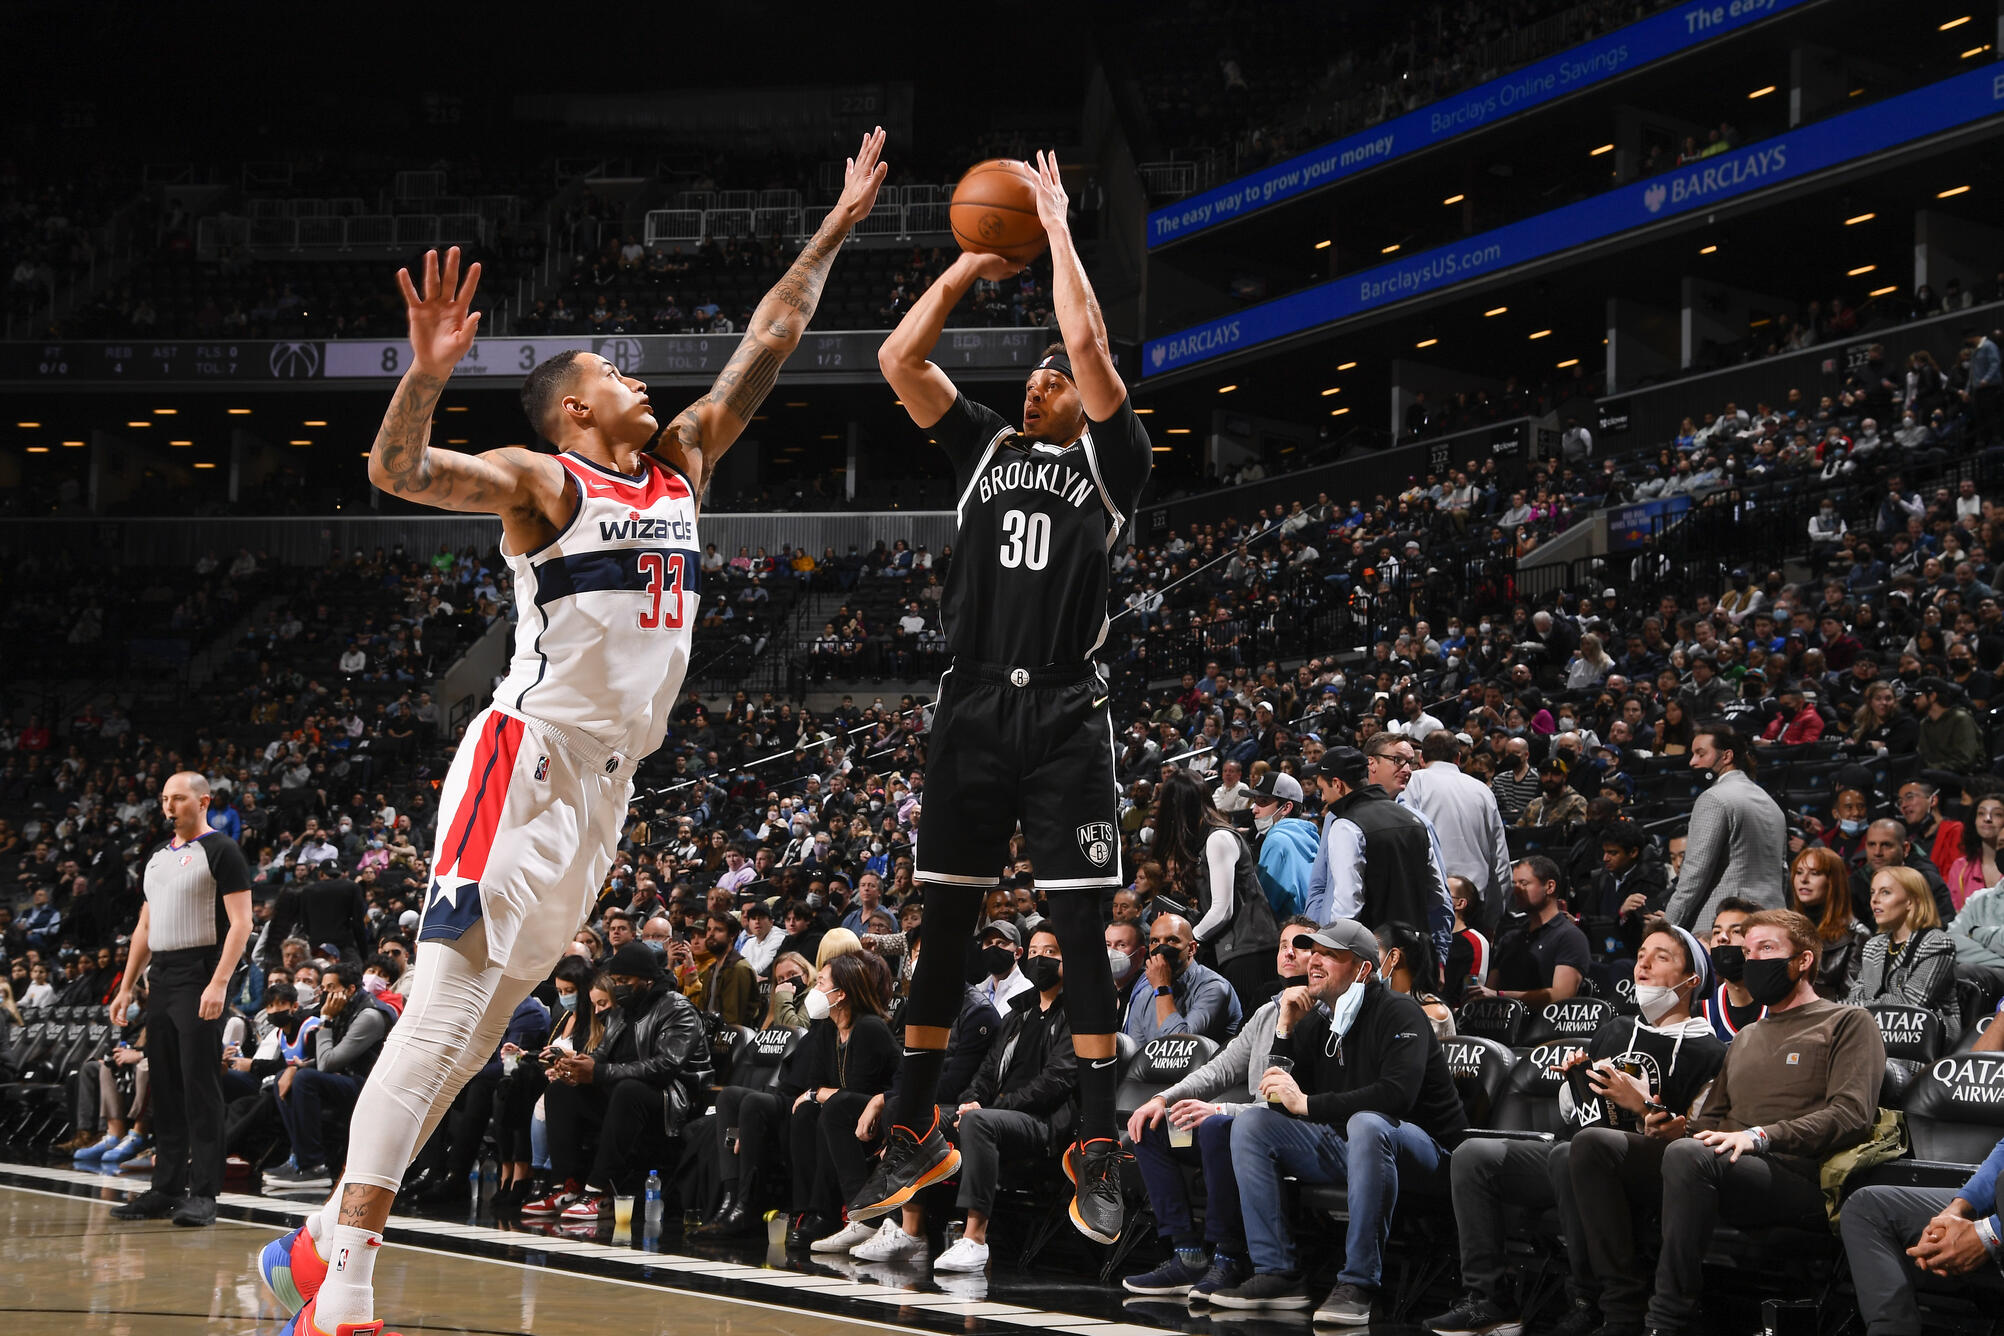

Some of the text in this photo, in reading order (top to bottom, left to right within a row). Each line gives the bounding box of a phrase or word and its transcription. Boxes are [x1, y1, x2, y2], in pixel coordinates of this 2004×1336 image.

[1685, 5, 1724, 34] The
[1431, 44, 1628, 133] Barclays Online Savings
[1671, 144, 1786, 203] BARCLAYS
[1156, 133, 1394, 236] The easy way to grow your money
[1360, 244, 1501, 301] BarclaysUS.com
[700, 340, 708, 352] 0
[818, 338, 842, 350] 3PT
[1002, 334, 1029, 347] AST
[1168, 321, 1240, 361] BARCLAYS
[44, 346, 61, 358] FT
[105, 346, 132, 358] REB
[152, 346, 177, 358] AST
[381, 347, 398, 372] 8
[519, 345, 536, 370] 3
[113, 362, 122, 373] 4
[229, 363, 237, 374] 7
[700, 356, 708, 368] 7
[1431, 450, 1448, 463] 122
[979, 461, 1095, 508] BROOKLYN
[999, 509, 1052, 571] 30
[638, 552, 685, 631] 33
[1080, 824, 1112, 845] NETS
[1096, 844, 1103, 860] B
[1542, 1003, 1603, 1023] QATAR
[1874, 1011, 1927, 1030] ATAR
[1554, 1020, 1598, 1032] AIRWAYS
[714, 1031, 738, 1045] TAR
[754, 1030, 792, 1046] QATAR
[1882, 1031, 1922, 1043] RWAYS
[758, 1044, 785, 1055] AIRWAYS
[1144, 1039, 1198, 1058] QATAR
[1442, 1043, 1486, 1064] TAR
[1530, 1045, 1588, 1069] QAT
[1151, 1057, 1190, 1069] AIRWAYS
